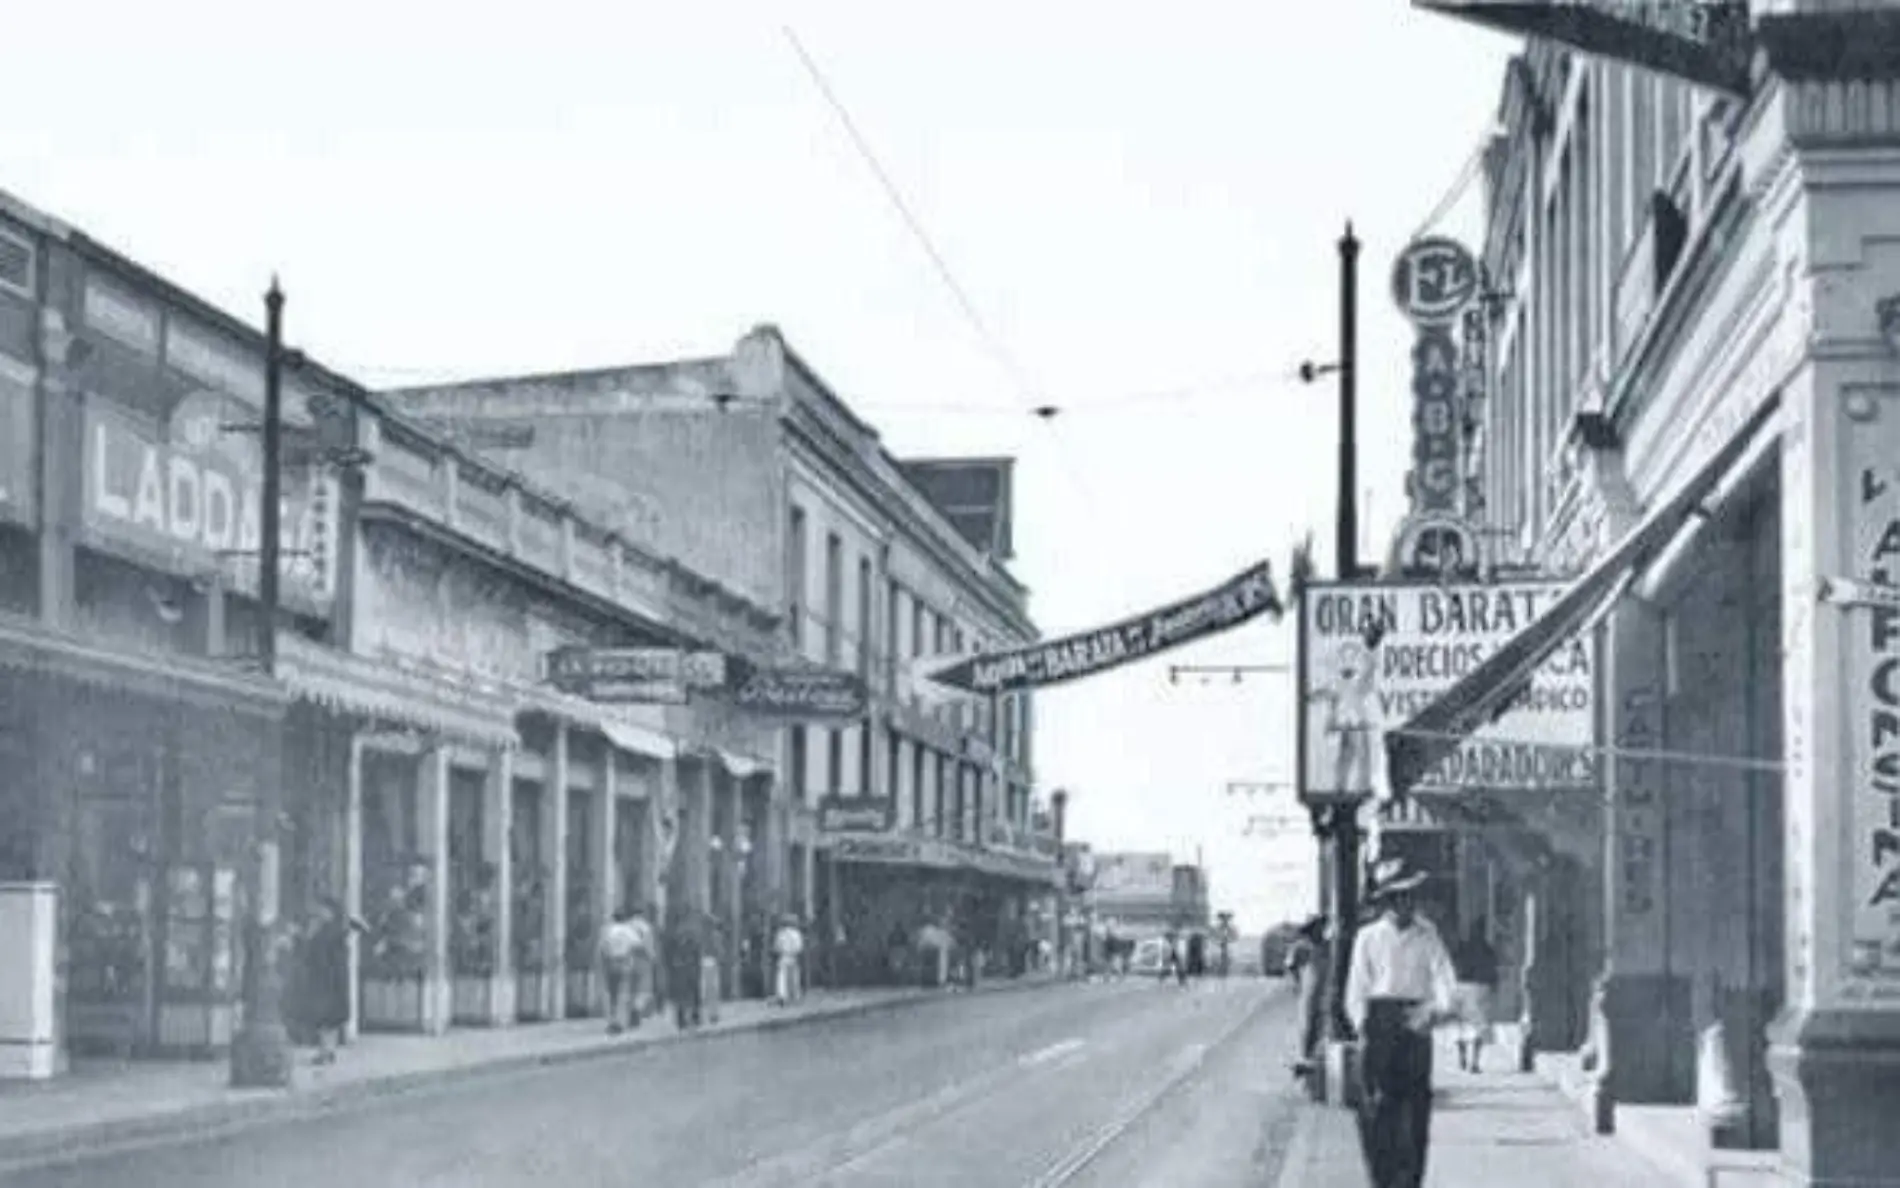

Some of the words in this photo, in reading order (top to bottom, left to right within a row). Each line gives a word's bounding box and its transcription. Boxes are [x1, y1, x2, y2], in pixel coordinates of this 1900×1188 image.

[1408, 247, 1470, 312] EL
[1315, 593, 1399, 635] GRAN
[1419, 589, 1563, 635] BARAT
[1382, 642, 1485, 679] PRECIOS
